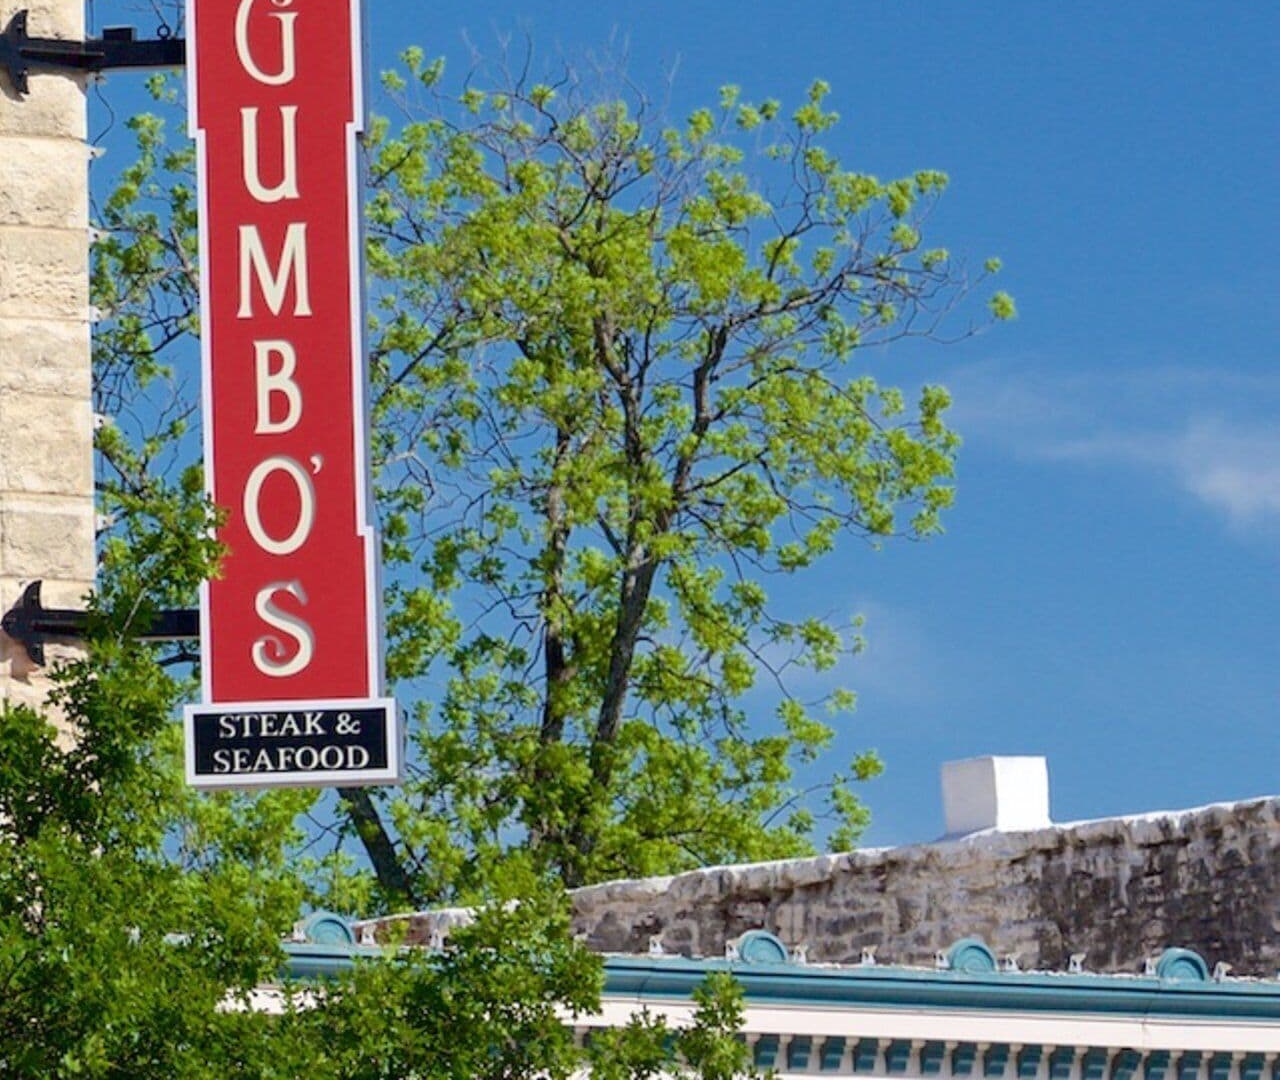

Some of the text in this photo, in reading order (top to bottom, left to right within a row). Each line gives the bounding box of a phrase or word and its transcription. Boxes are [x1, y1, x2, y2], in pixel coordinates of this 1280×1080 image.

[218, 711, 362, 739] STEAK &
[212, 744, 370, 774] SEAFOOD
